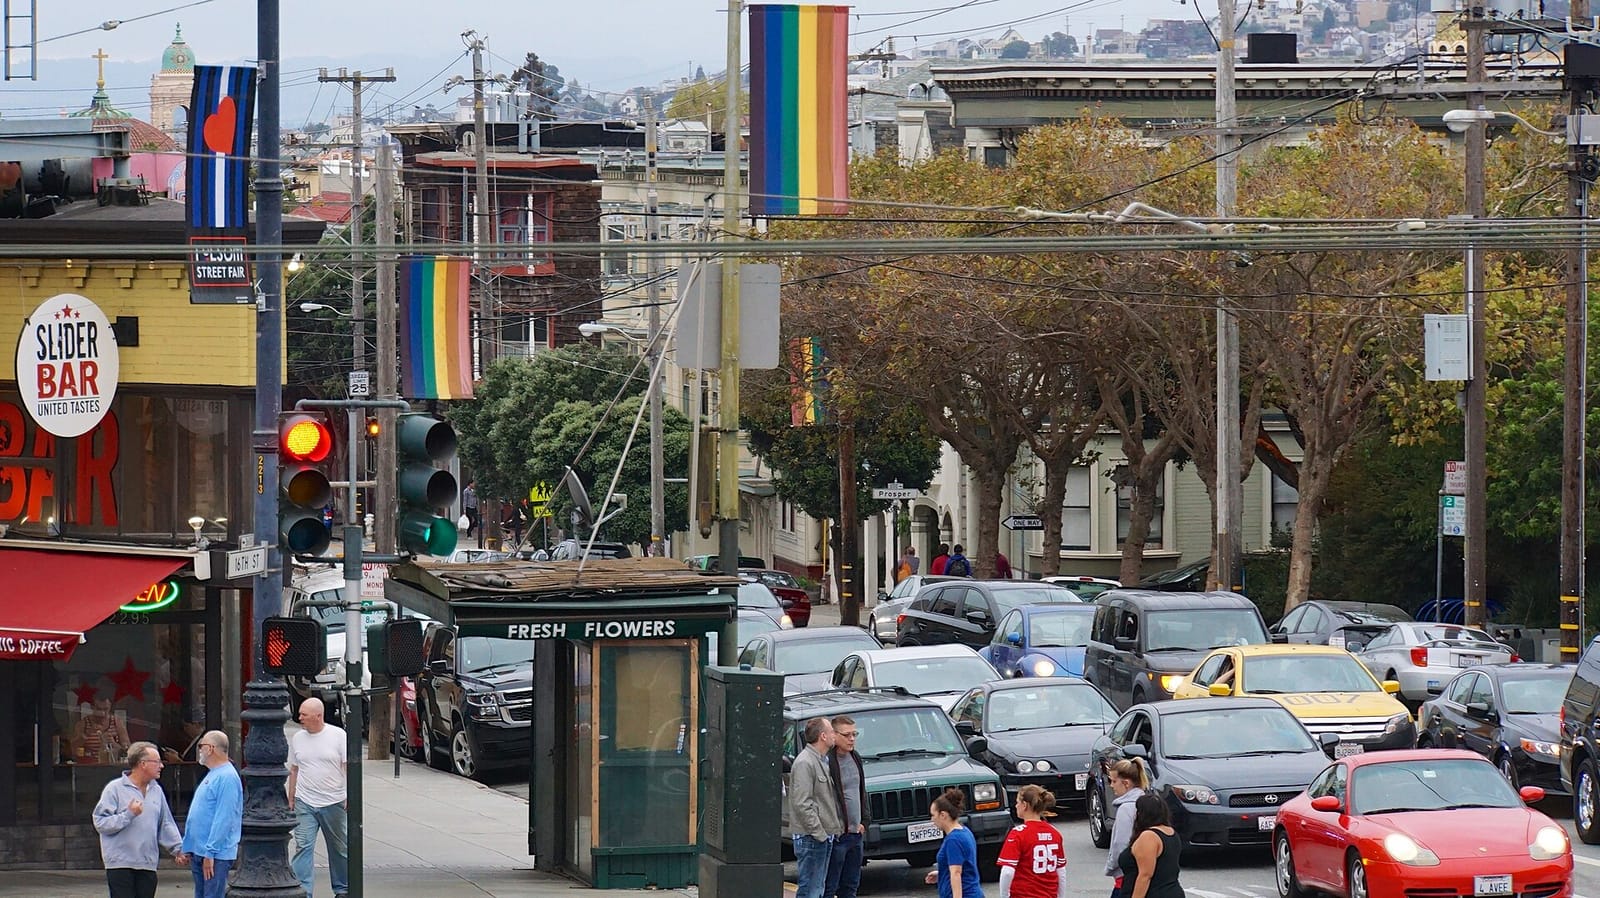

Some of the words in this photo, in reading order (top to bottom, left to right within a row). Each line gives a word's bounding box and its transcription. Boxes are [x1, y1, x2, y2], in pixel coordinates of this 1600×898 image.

[196, 266, 226, 279] STREET
[228, 266, 245, 278] FAIR
[37, 321, 98, 360] SLIDER
[37, 361, 99, 398] BAR
[351, 383, 367, 393] 25
[38, 402, 68, 416] UNITED
[70, 400, 100, 414] TASTES
[878, 490, 912, 498] Prosper
[234, 555, 249, 572] 16TH
[253, 553, 260, 569] ST
[507, 622, 567, 639] FRESH
[584, 620, 676, 638] FLOWERS
[19, 638, 65, 654] COFFEE
[1032, 843, 1059, 874] 85
